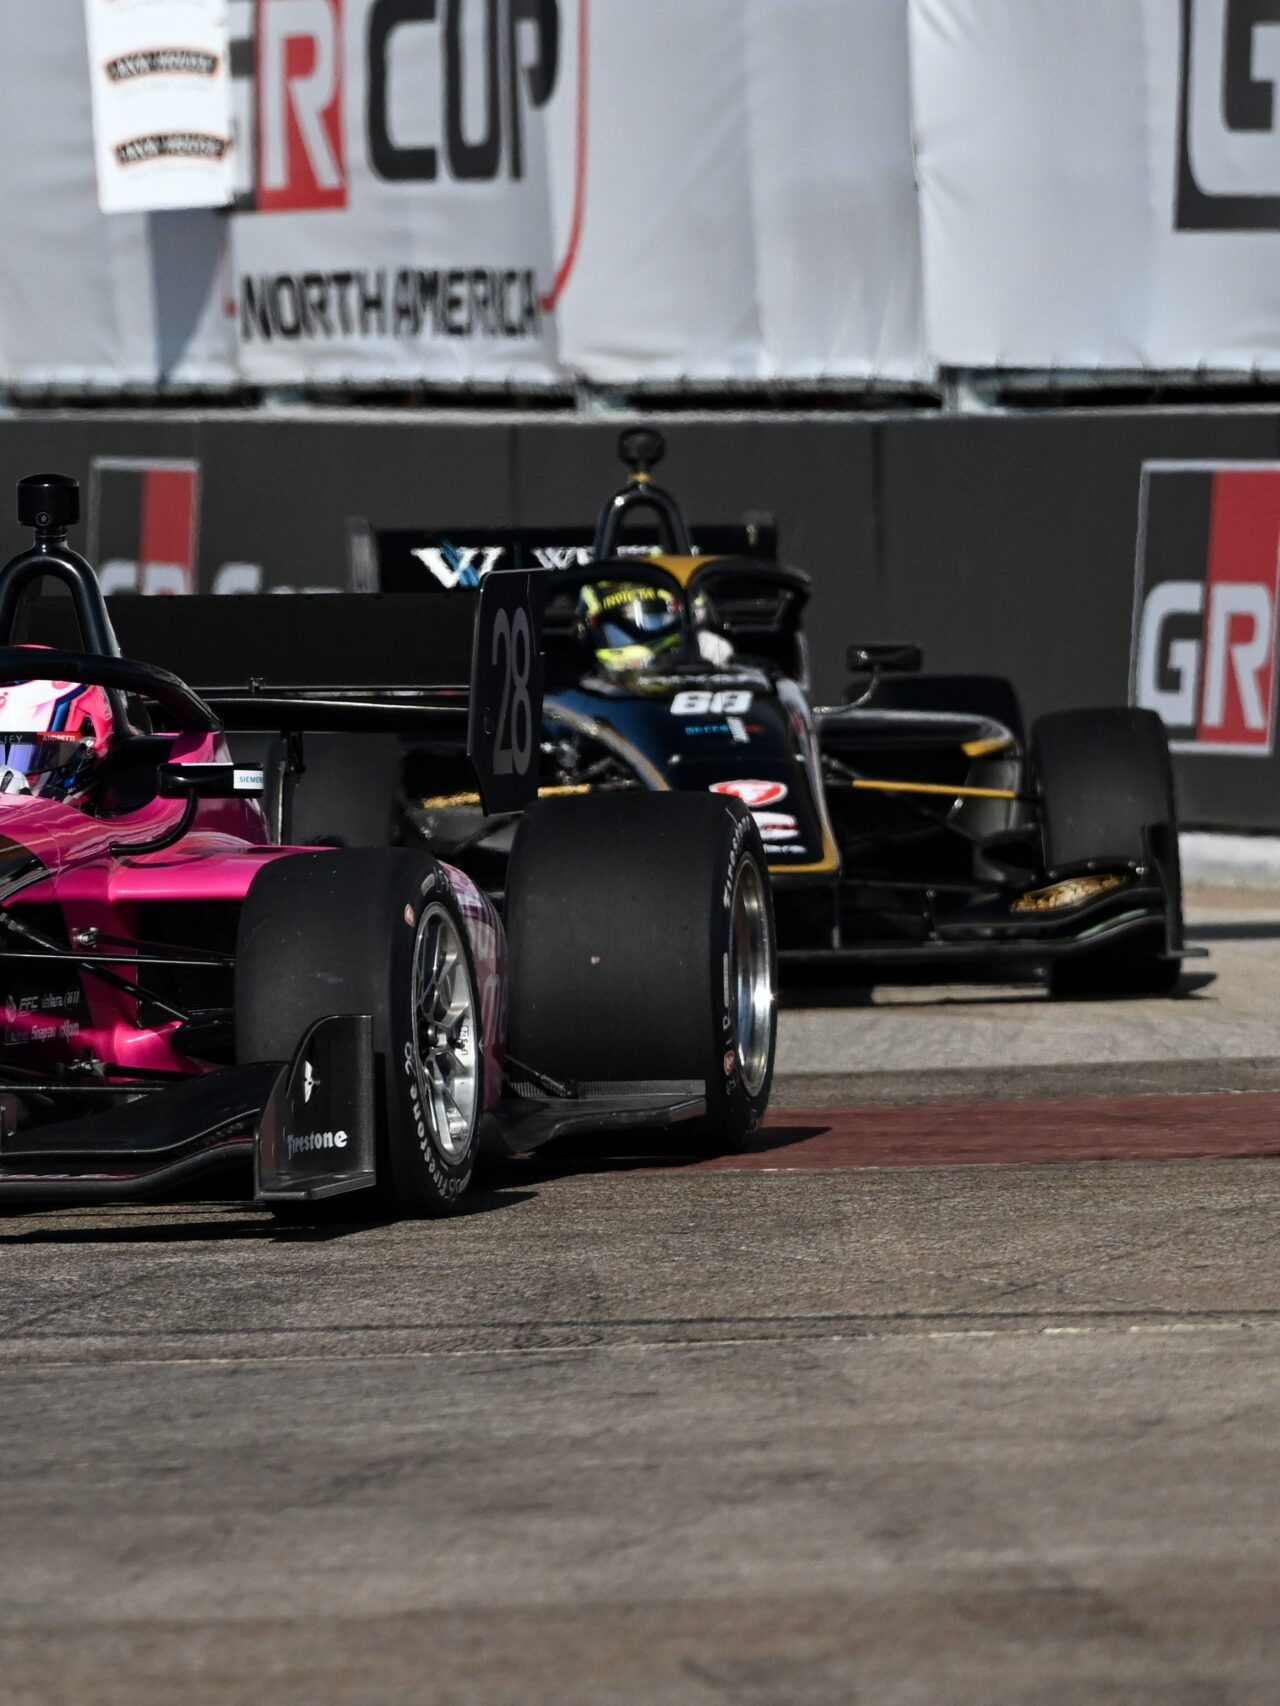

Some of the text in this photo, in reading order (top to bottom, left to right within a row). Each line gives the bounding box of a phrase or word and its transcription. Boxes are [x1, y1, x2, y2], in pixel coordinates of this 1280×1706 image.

[366, 0, 560, 182] CUP
[240, 267, 542, 342] NORTH AMERICA
[491, 607, 532, 776] 28
[1136, 579, 1273, 730] GR
[43, 734, 76, 742] ANDRETTI
